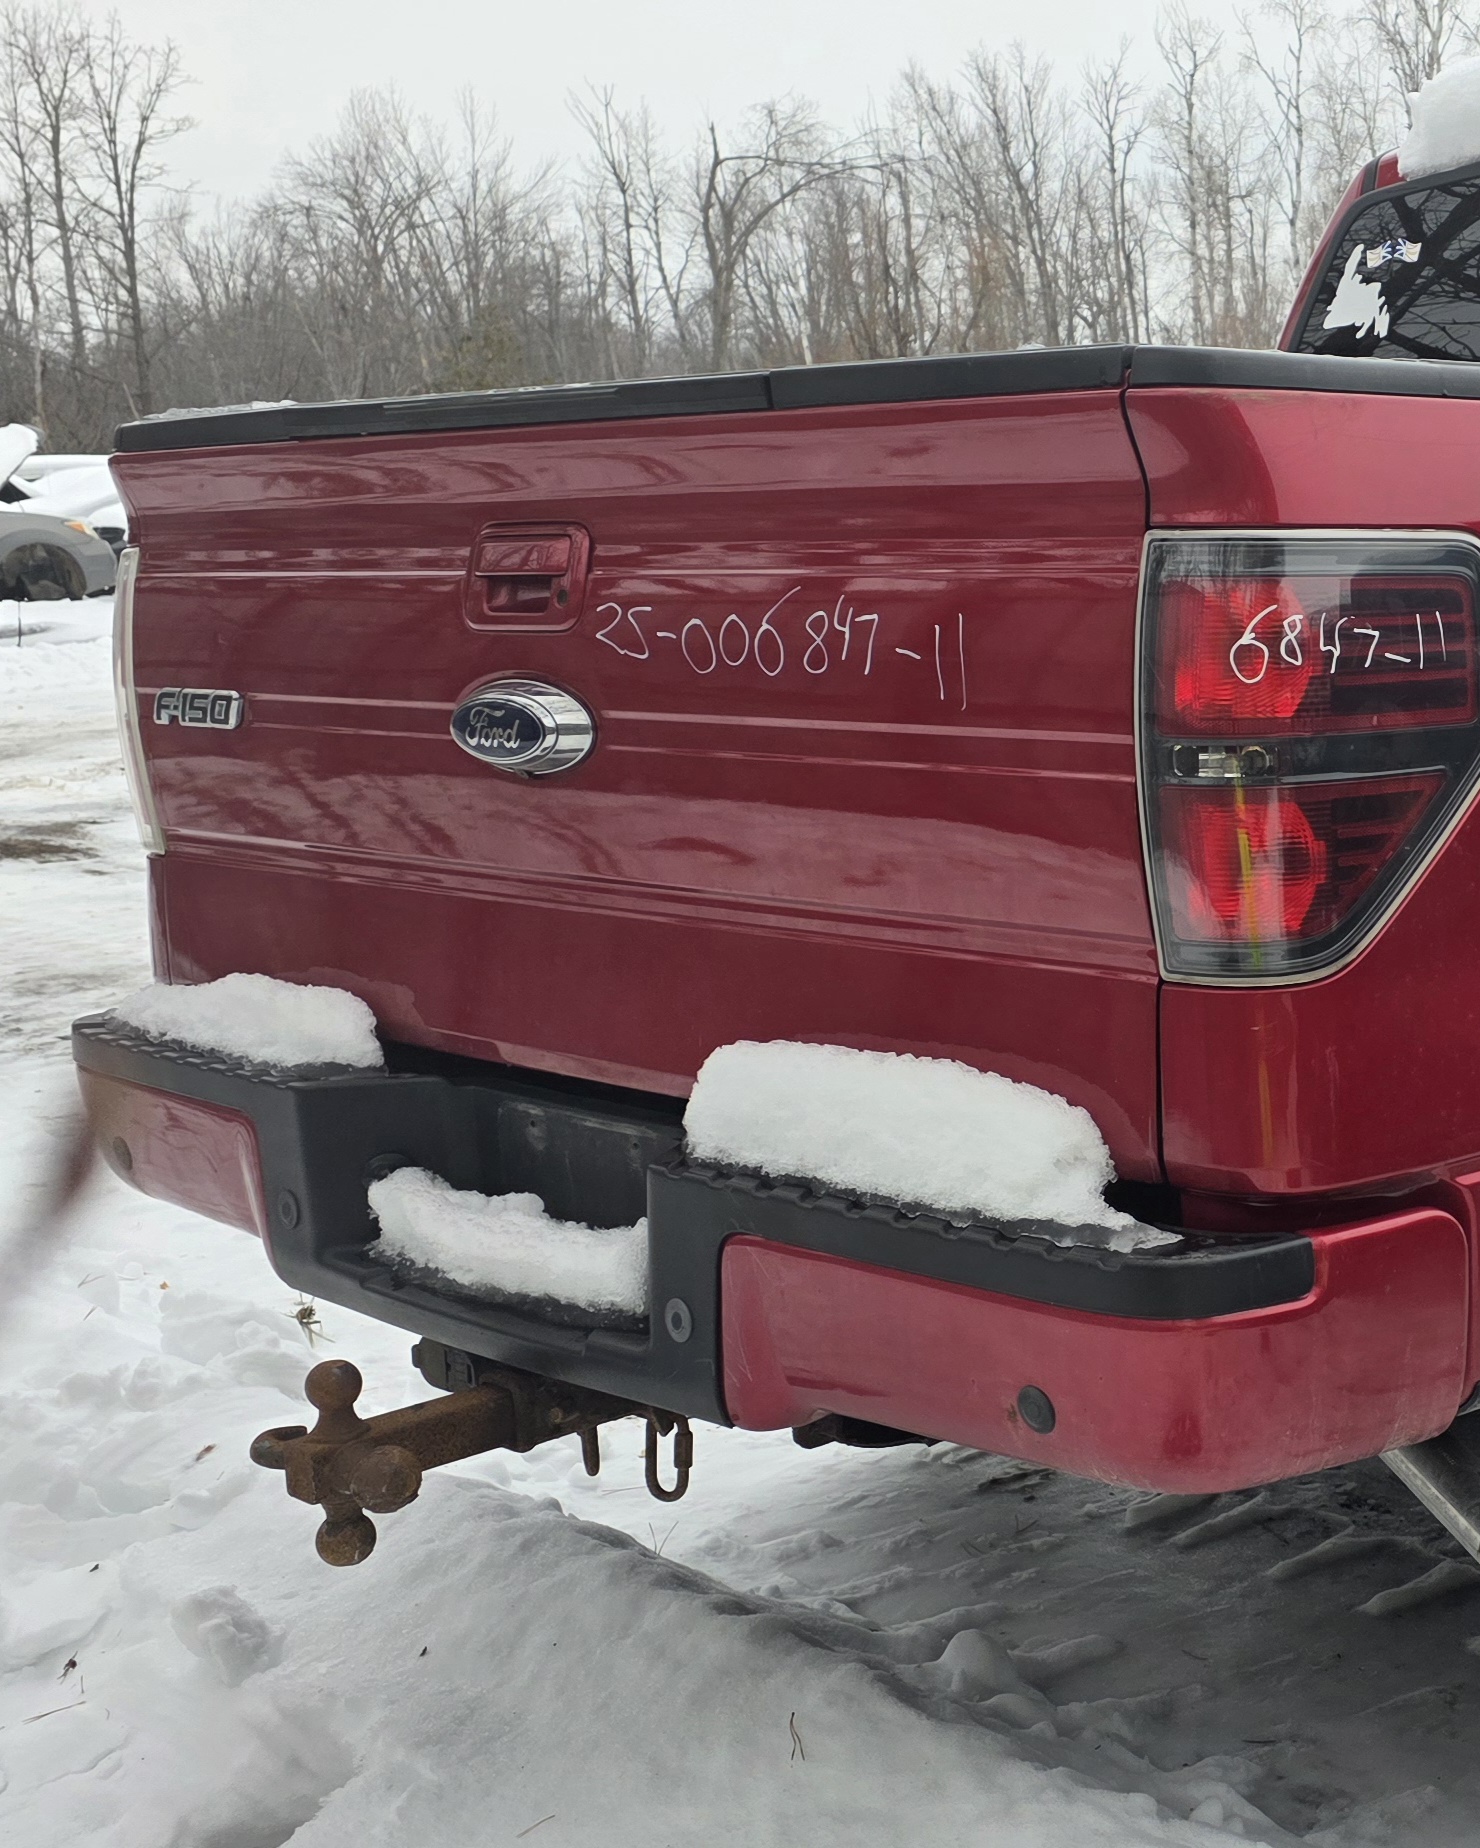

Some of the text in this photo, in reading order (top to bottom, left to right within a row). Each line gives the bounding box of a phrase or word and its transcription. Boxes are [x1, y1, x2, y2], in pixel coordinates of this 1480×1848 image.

[595, 586, 968, 712] 25-006847-11
[1229, 604, 1447, 684] 6847-11
[154, 687, 243, 730] F-150
[464, 704, 521, 751] Ford
